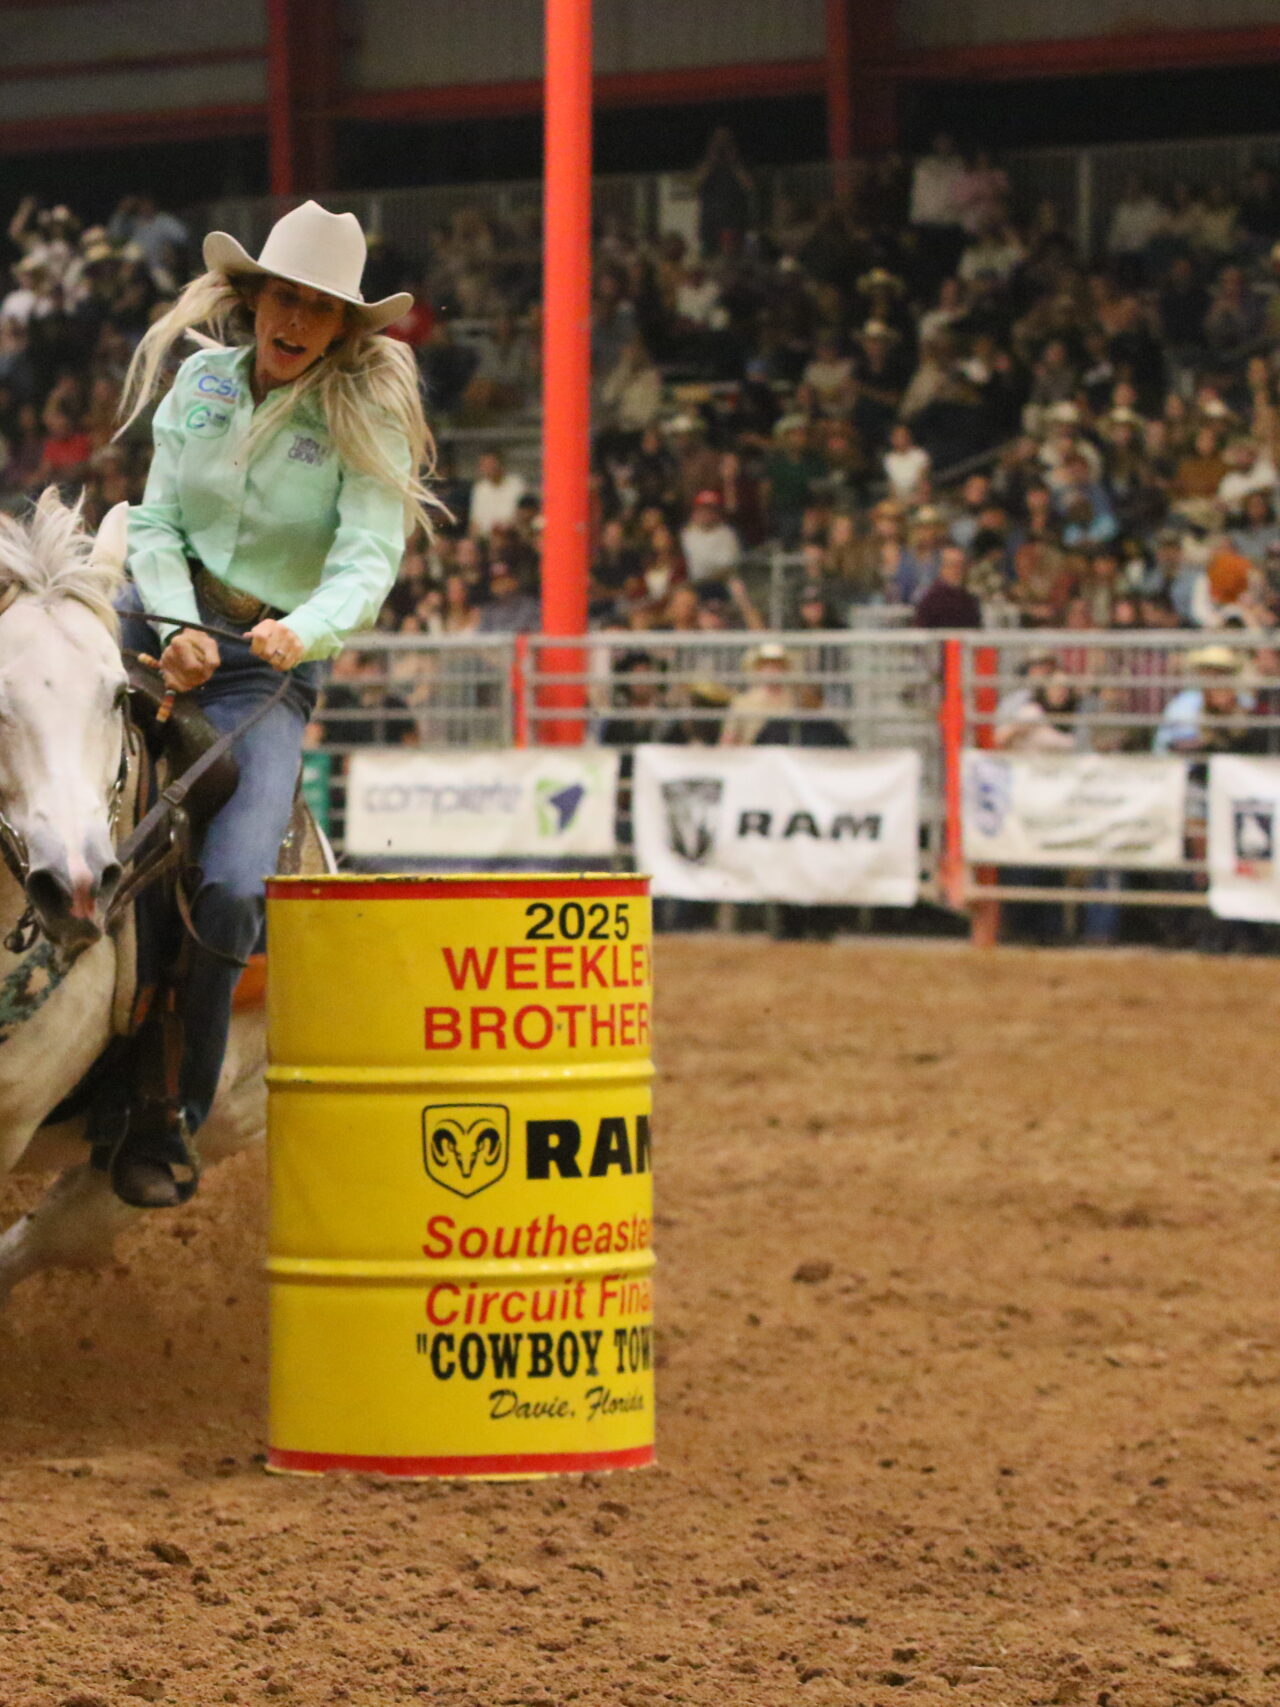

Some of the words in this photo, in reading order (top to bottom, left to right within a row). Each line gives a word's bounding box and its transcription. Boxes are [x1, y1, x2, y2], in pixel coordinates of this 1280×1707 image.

[737, 810, 883, 840] RAM
[524, 902, 630, 941] 2025
[441, 944, 651, 991] WEEKLE
[421, 1214, 652, 1260] Southeaste
[425, 1277, 585, 1327] Circuit
